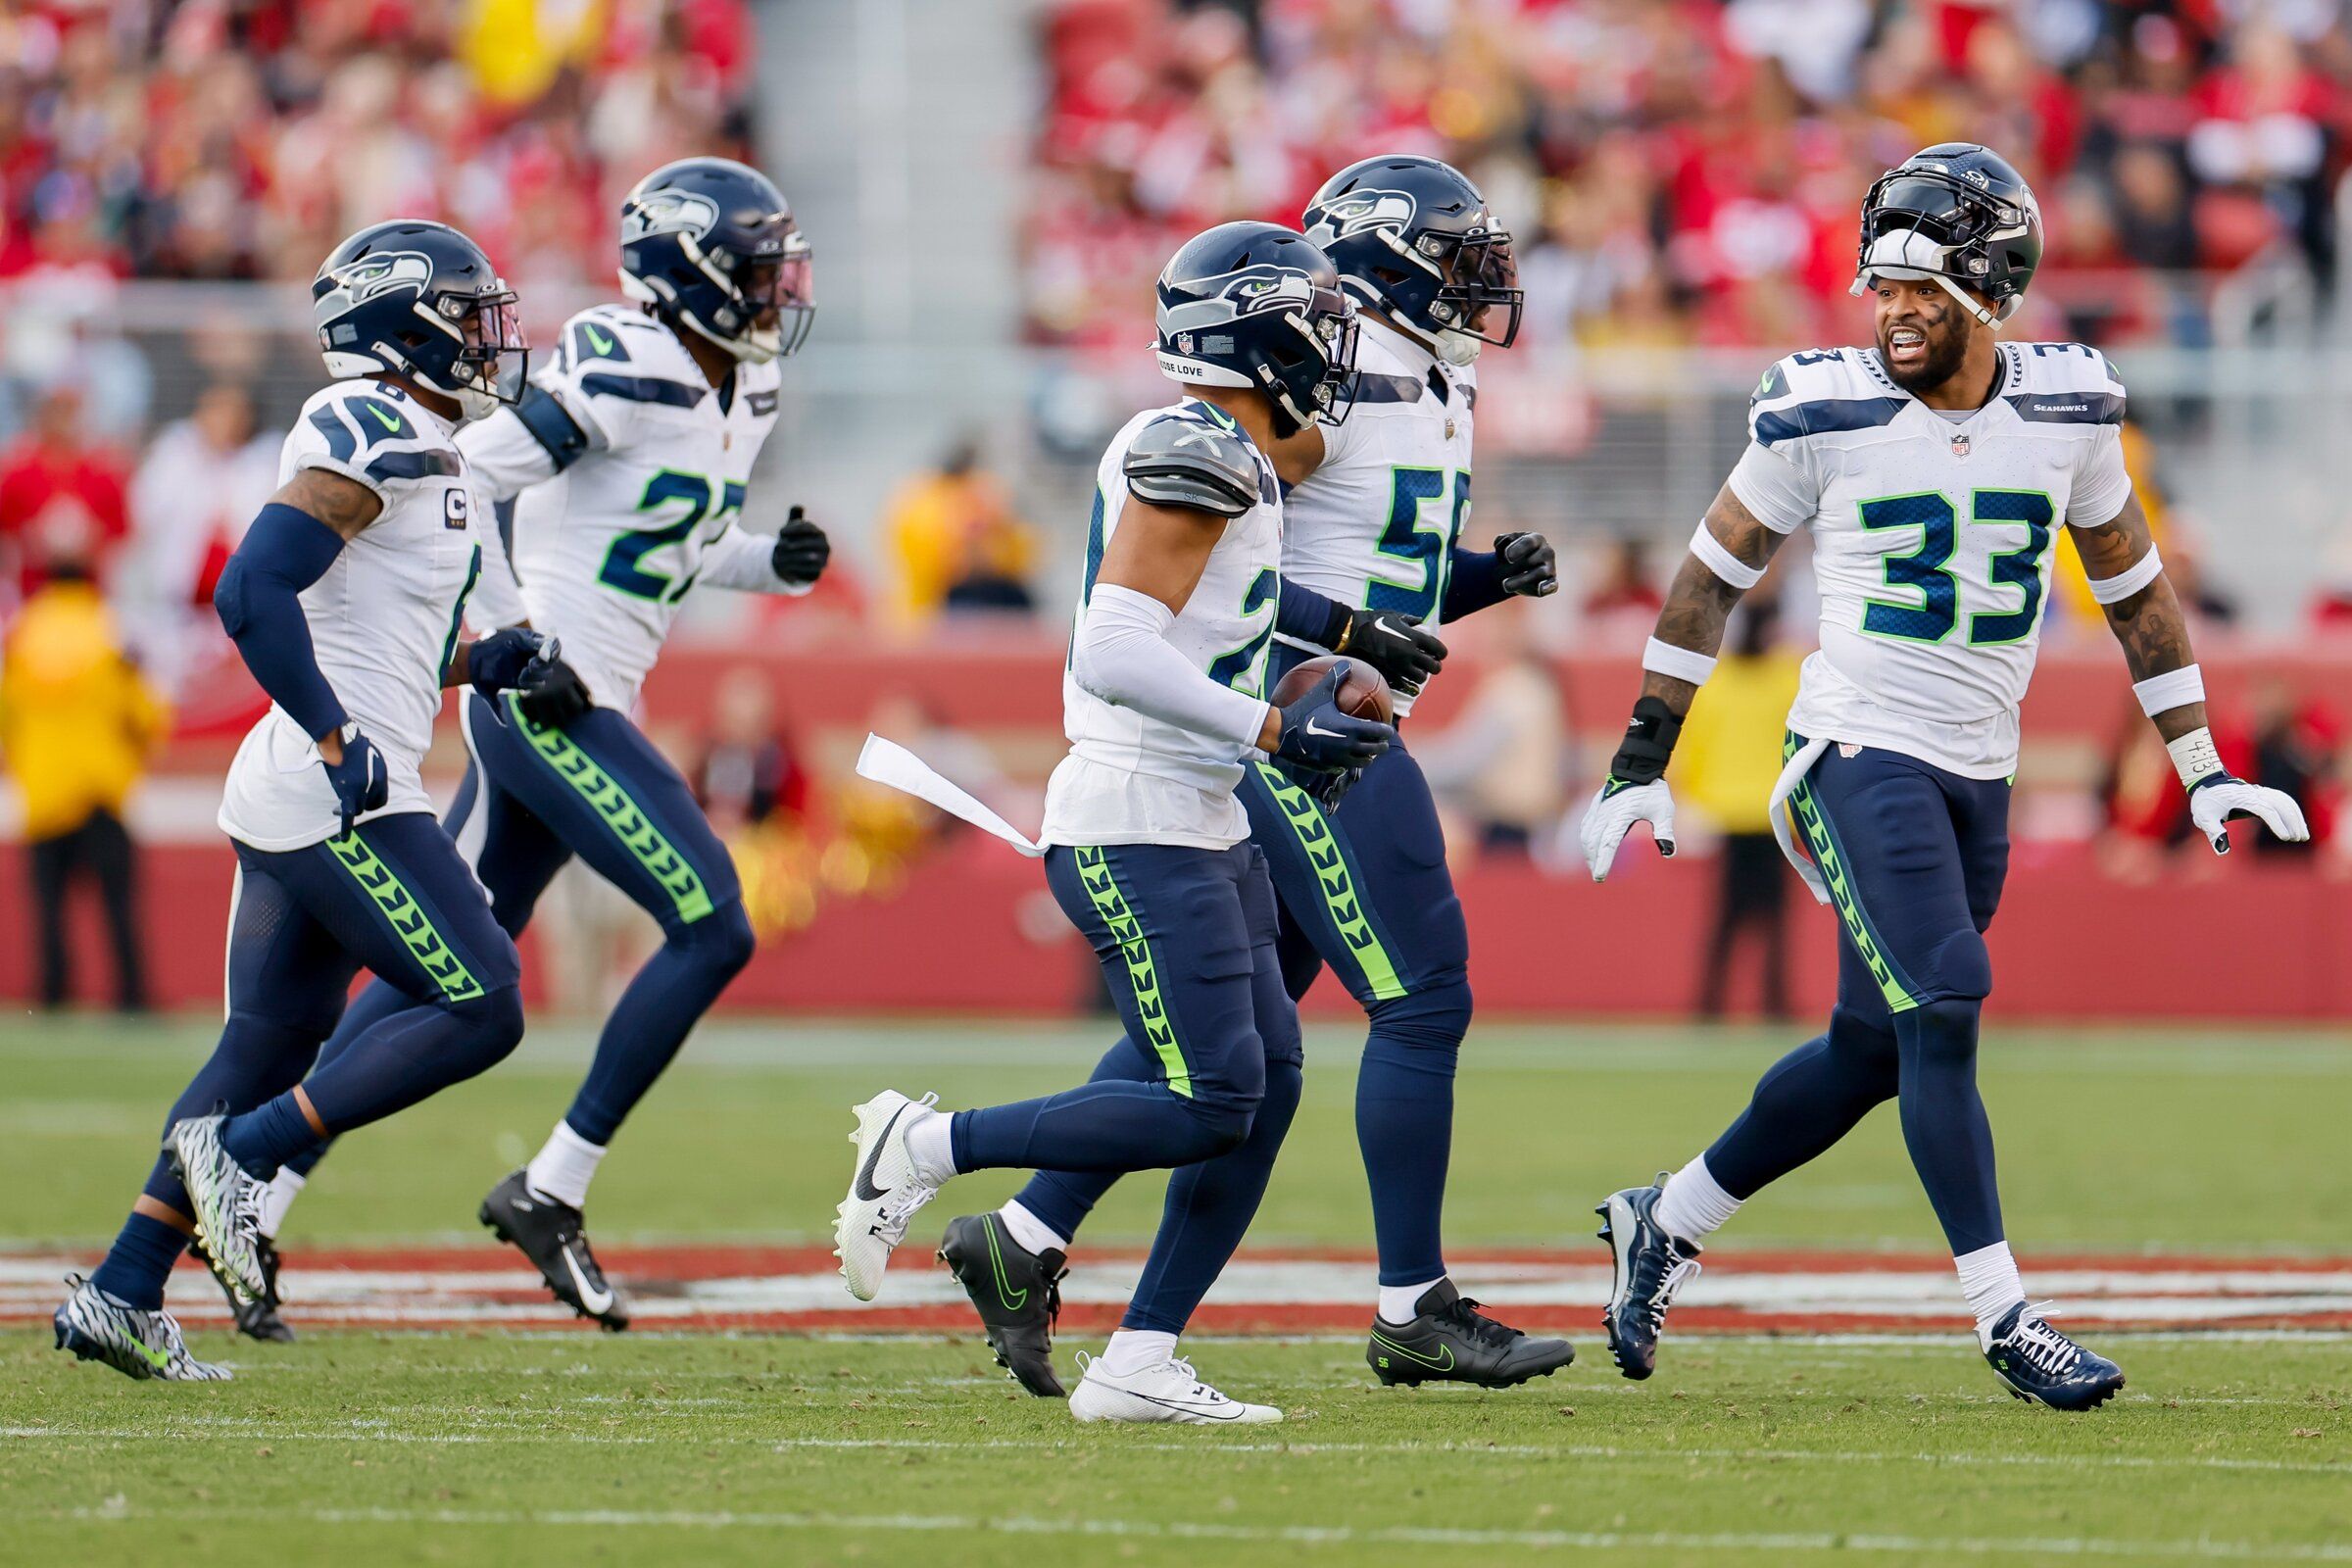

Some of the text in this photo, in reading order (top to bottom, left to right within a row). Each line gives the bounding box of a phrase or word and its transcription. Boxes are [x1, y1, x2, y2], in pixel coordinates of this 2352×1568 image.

[1177, 364, 1203, 377] LOVE
[2033, 403, 2089, 413] SEAHAWKS
[446, 489, 466, 520] C
[1856, 487, 2057, 648] 33
[1206, 564, 1281, 702] 2
[2187, 740, 2212, 773] 4:13
